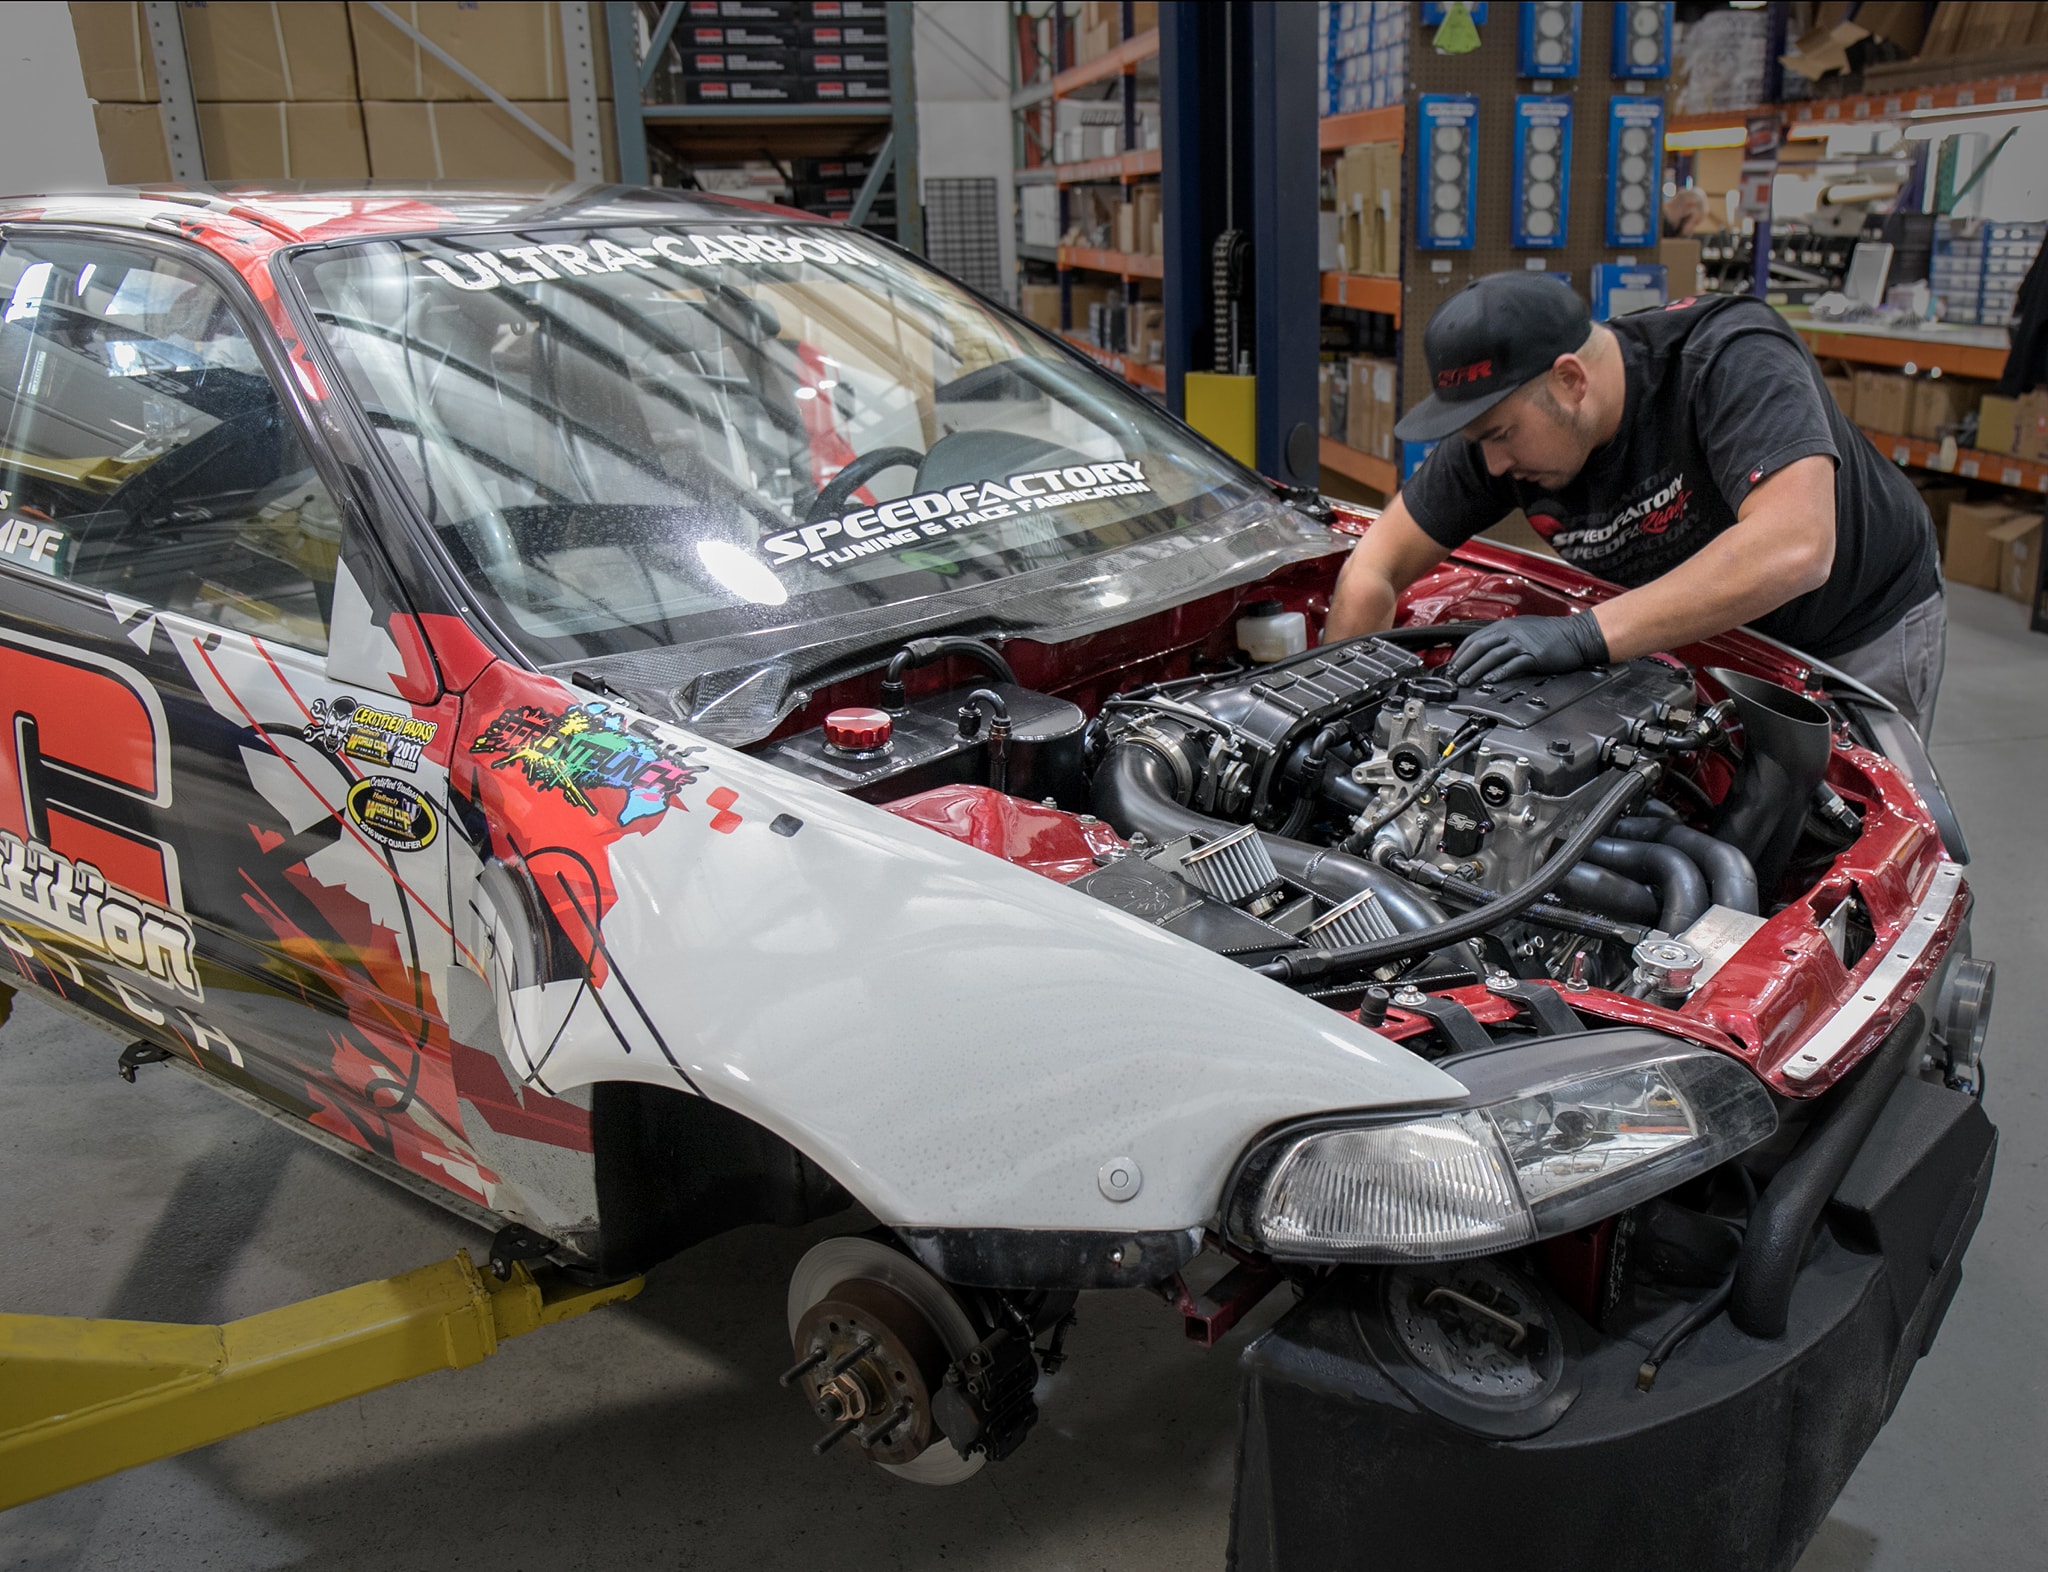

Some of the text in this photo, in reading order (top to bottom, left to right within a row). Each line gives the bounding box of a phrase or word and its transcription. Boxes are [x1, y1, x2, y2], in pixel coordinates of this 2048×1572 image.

[423, 234, 880, 291] ULTRA-CARBON
[764, 460, 1147, 566] SPEEDFACTORY
[810, 480, 1151, 569] TUNING & RACE FABRICATION
[353, 707, 437, 743] CERTIFIED BADASS
[395, 740, 422, 762] 2017
[372, 791, 399, 806] Haltech
[388, 839, 422, 850] QUALIFIER
